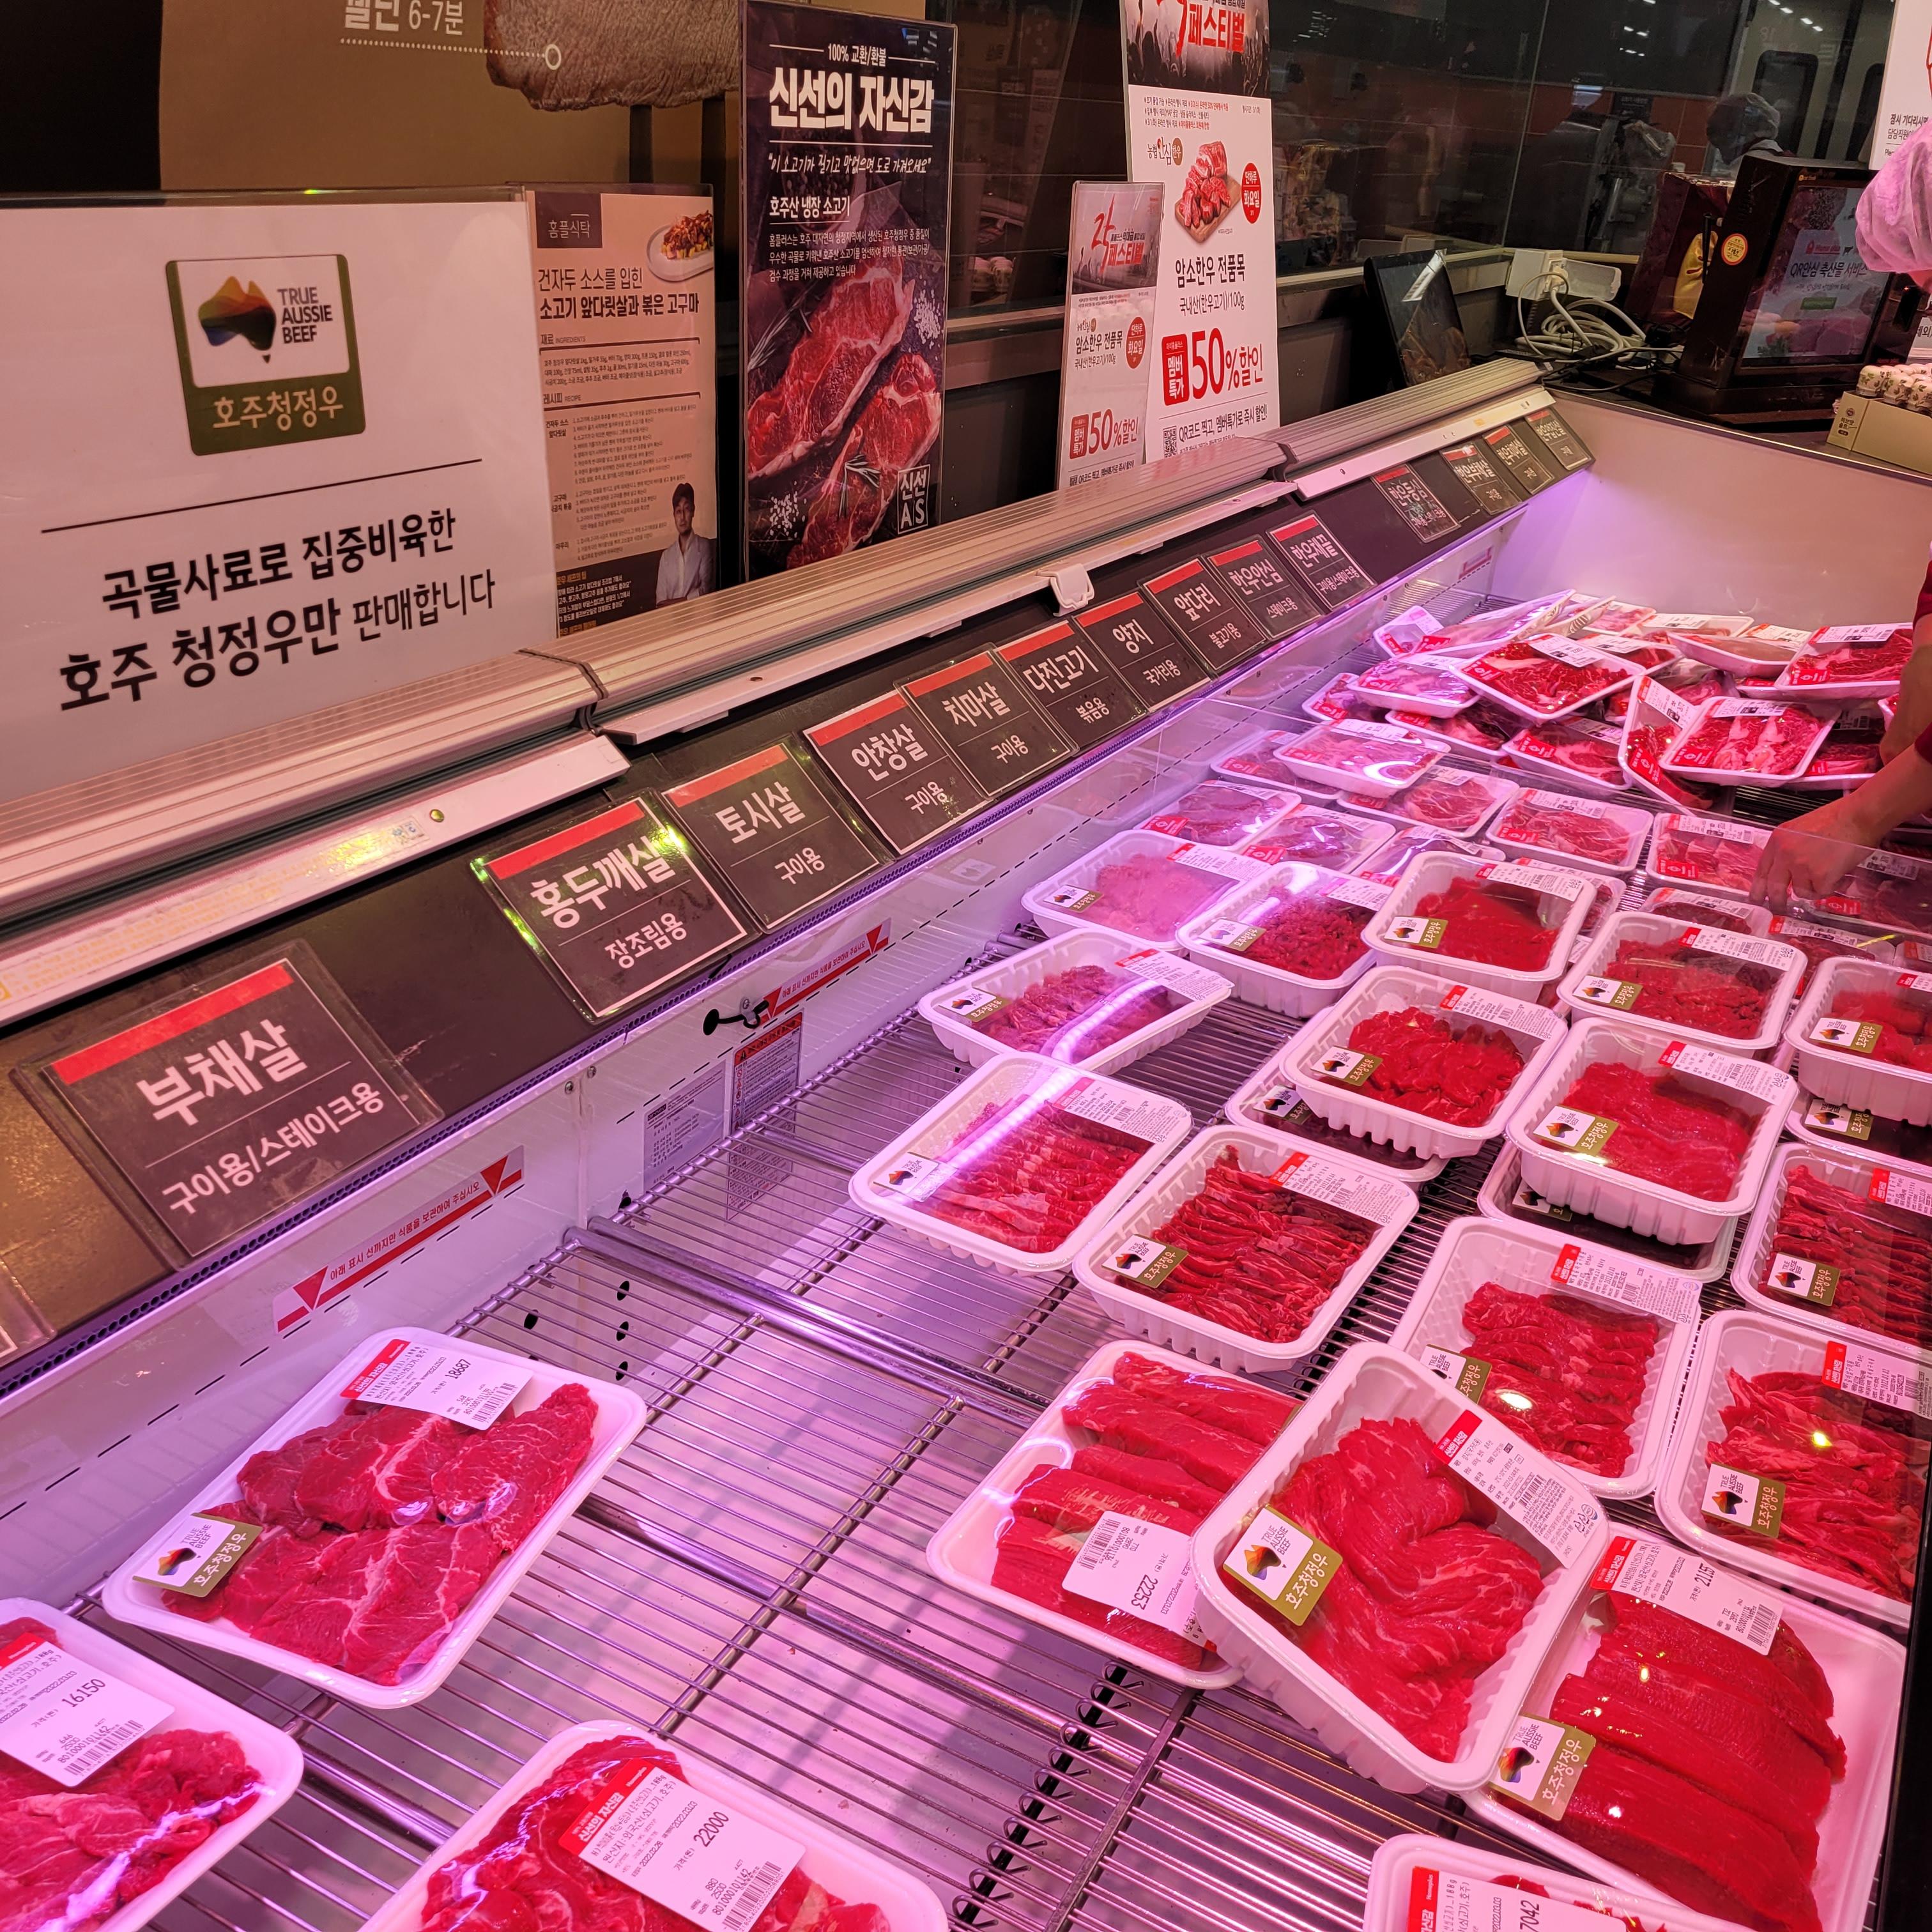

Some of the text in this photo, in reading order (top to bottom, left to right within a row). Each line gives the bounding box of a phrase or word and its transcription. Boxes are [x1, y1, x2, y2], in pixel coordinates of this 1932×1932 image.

[1188, 4, 1245, 53] 페스티벌
[828, 43, 886, 66] 100% 교환/환불
[769, 67, 934, 134] 신선의 자신감
[781, 154, 815, 172] 소고기가
[818, 155, 839, 173] 질기고
[844, 155, 874, 173] 맛없으면
[875, 158, 889, 172] 도로
[769, 196, 850, 218] 호주산 냉장 소고기
[1244, 190, 1260, 208] 화요일
[548, 220, 590, 238] 홈플식탁
[769, 233, 798, 247] 홈플러스는
[800, 234, 810, 244] 호주
[813, 233, 834, 244] 대자연의
[835, 231, 866, 243] 청정지역에서
[868, 230, 882, 242] 생산된
[910, 231, 915, 240] 중
[916, 229, 930, 240] 품질이
[769, 252, 786, 265] 우수한
[788, 251, 805, 263] 곡물로
[823, 249, 839, 261] 호주산
[840, 248, 860, 259] 소고기를
[1108, 242, 1145, 266] 페스티벌
[538, 267, 643, 292] 건자두 소스를 입힌
[769, 264, 856, 282] 검수 과정을 거쳐 제공하고 있습니다
[1176, 254, 1245, 288] 암소한우 전품목
[278, 286, 318, 304] TRUE
[540, 293, 699, 319] 소고기 앞다릿살과 볶은 고구마
[281, 304, 333, 325] AUSSIE
[282, 326, 317, 344] BEEF
[1076, 331, 1123, 354] 암소한우 전품목
[1128, 339, 1143, 355] 화요일
[212, 386, 344, 431] 호주청정우
[543, 394, 562, 404] 레시피
[1179, 423, 1200, 442] QR코드
[1245, 406, 1254, 425] 즉시
[900, 469, 926, 501] 신선
[102, 508, 456, 619] 곡물사료로 집중비육한
[1291, 533, 1338, 570] 한우채끝
[1229, 560, 1284, 597] 한우안심
[1174, 583, 1220, 621] 앞다리
[1266, 597, 1298, 620] 스테이크용
[60, 643, 157, 710] 호주
[172, 599, 341, 687] 청정우만
[353, 569, 496, 640] 판매합니다
[1113, 620, 1154, 654] 양지
[1209, 621, 1241, 648] 불고기용
[1023, 644, 1098, 694] 다진고기
[1144, 659, 1181, 687] 국거리용
[942, 682, 1010, 727] 치마살
[1075, 697, 1110, 724] 볶음용
[851, 723, 928, 782] 안창살
[992, 735, 1029, 765] 구이용
[715, 781, 806, 845] 토시살
[905, 782, 949, 815] 구이용
[774, 848, 825, 885] 구이용
[531, 836, 677, 930] 홍두깨살
[605, 912, 689, 970] 장조림용
[135, 1018, 308, 1128] 부채살
[162, 1082, 385, 1216] 구이용/스테이크용
[330, 1181, 479, 1280] 아래 표시 선까지만 식품을 보관하여 주십시오
[445, 1359, 471, 1379] 18687
[1758, 1487, 1778, 1529] 호주청정우
[189, 1524, 211, 1546] AUSSIE
[195, 1534, 211, 1549] BEEF
[1261, 1524, 1278, 1542] TRUE
[1270, 1526, 1289, 1549] AUSSIE
[1276, 1538, 1291, 1555] BEEF
[194, 1533, 247, 1586] 호주청정우
[1131, 1574, 1158, 1610] 22253
[1285, 1552, 1328, 1610] 호주청정우
[62, 1678, 105, 1707] 16150
[1514, 1726, 1528, 1742] TRUE
[1522, 1723, 1540, 1746] AUSSIE
[1529, 1733, 1544, 1750] BEEF
[1542, 1738, 1583, 1805] 호주청정우
[694, 1811, 729, 1847] 22000
[712, 1868, 752, 1915] 801000101142
